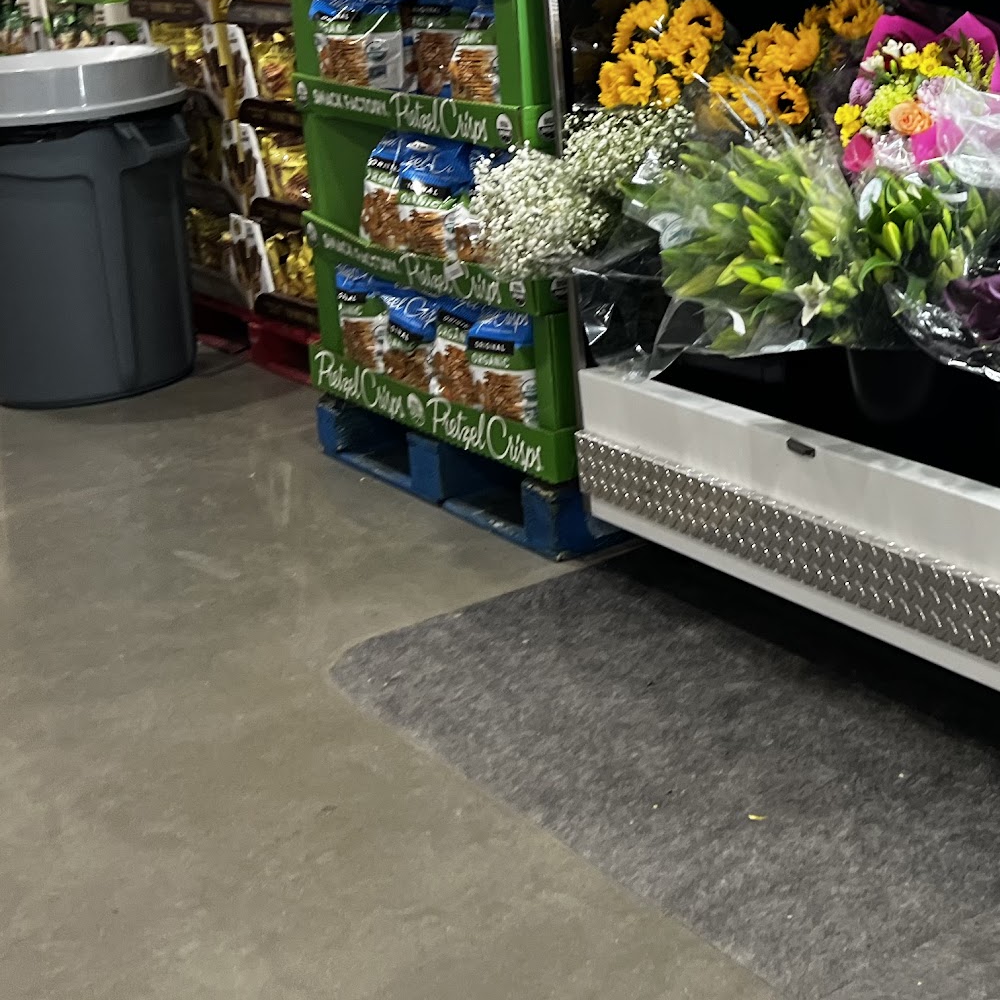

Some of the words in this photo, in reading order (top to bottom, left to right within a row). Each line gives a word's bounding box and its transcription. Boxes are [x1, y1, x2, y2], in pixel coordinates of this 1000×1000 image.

[390, 91, 440, 135] Pretzel
[439, 98, 488, 144] Crisps
[314, 350, 361, 400] Pretzel
[360, 367, 405, 420] Crisps
[426, 396, 486, 451] Pretzel
[486, 415, 544, 473] Crisps
